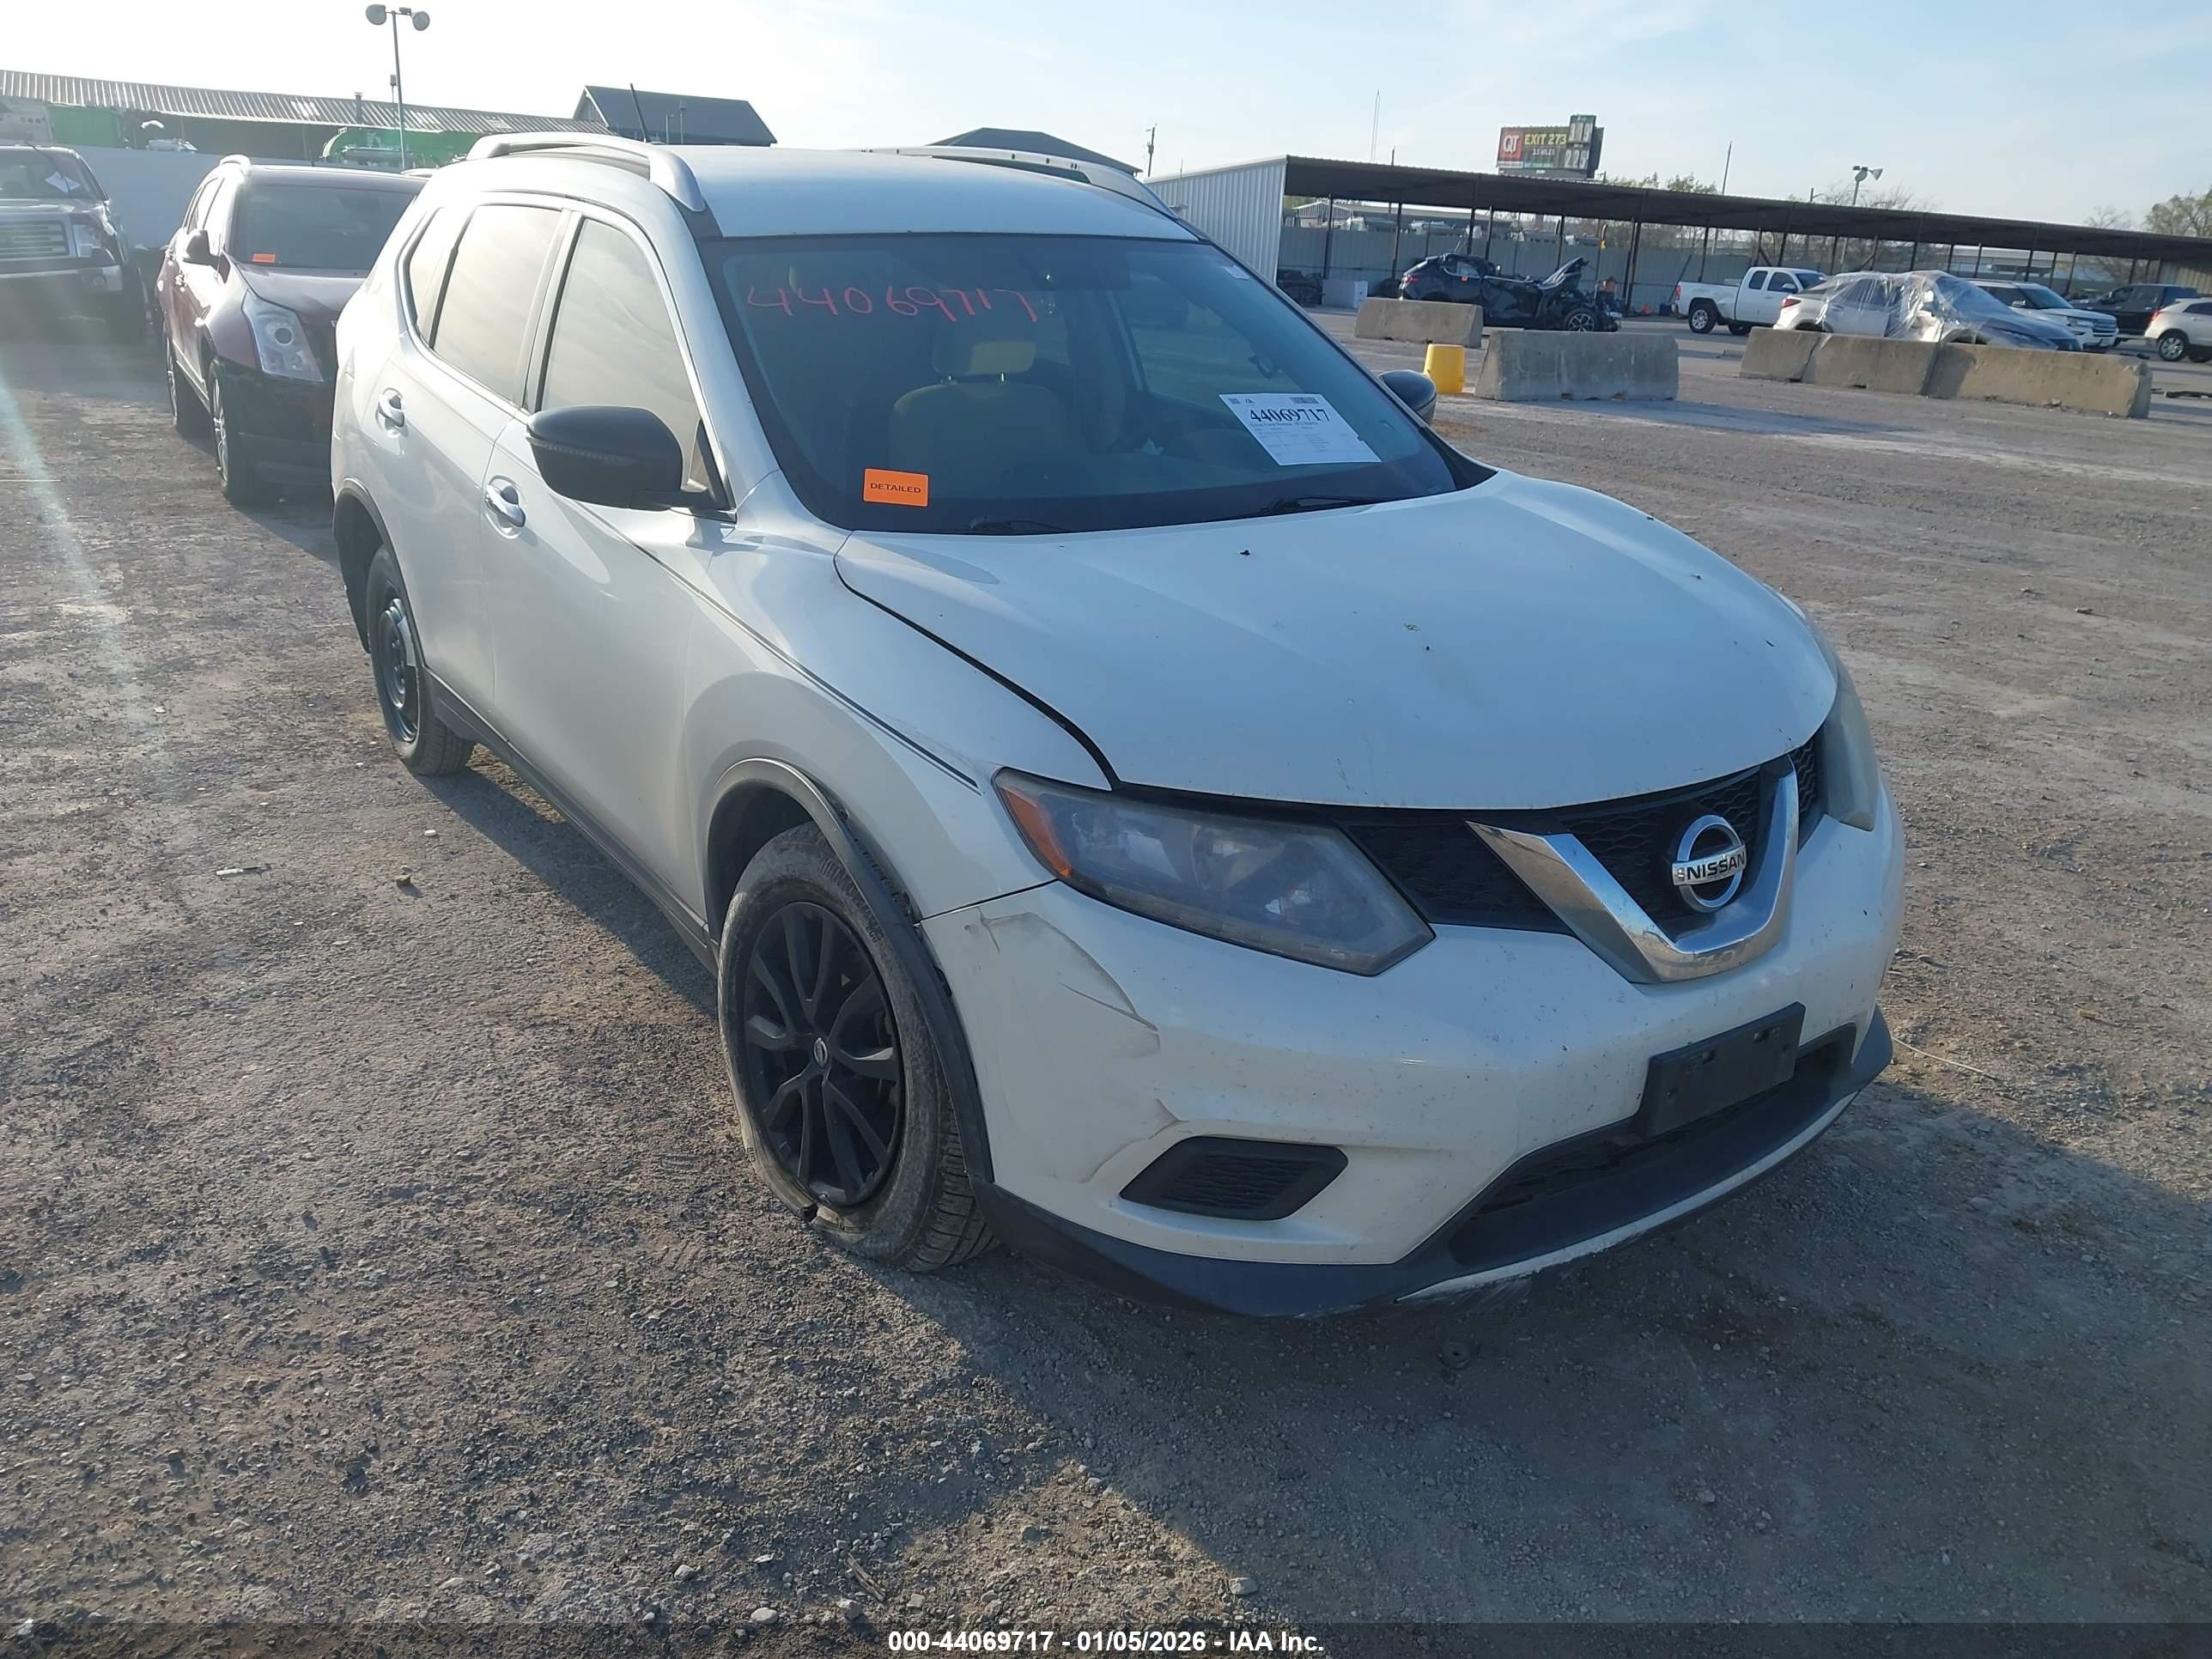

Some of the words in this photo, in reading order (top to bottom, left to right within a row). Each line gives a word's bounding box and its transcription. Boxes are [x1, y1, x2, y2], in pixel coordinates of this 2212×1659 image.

[1503, 134, 1520, 155] QT
[1524, 133, 1547, 145] EXIT
[1547, 133, 1567, 145] 273
[1250, 408, 1330, 422] 44069717
[870, 483, 921, 494] DETAILED
[1686, 851, 1746, 880] NISSAN
